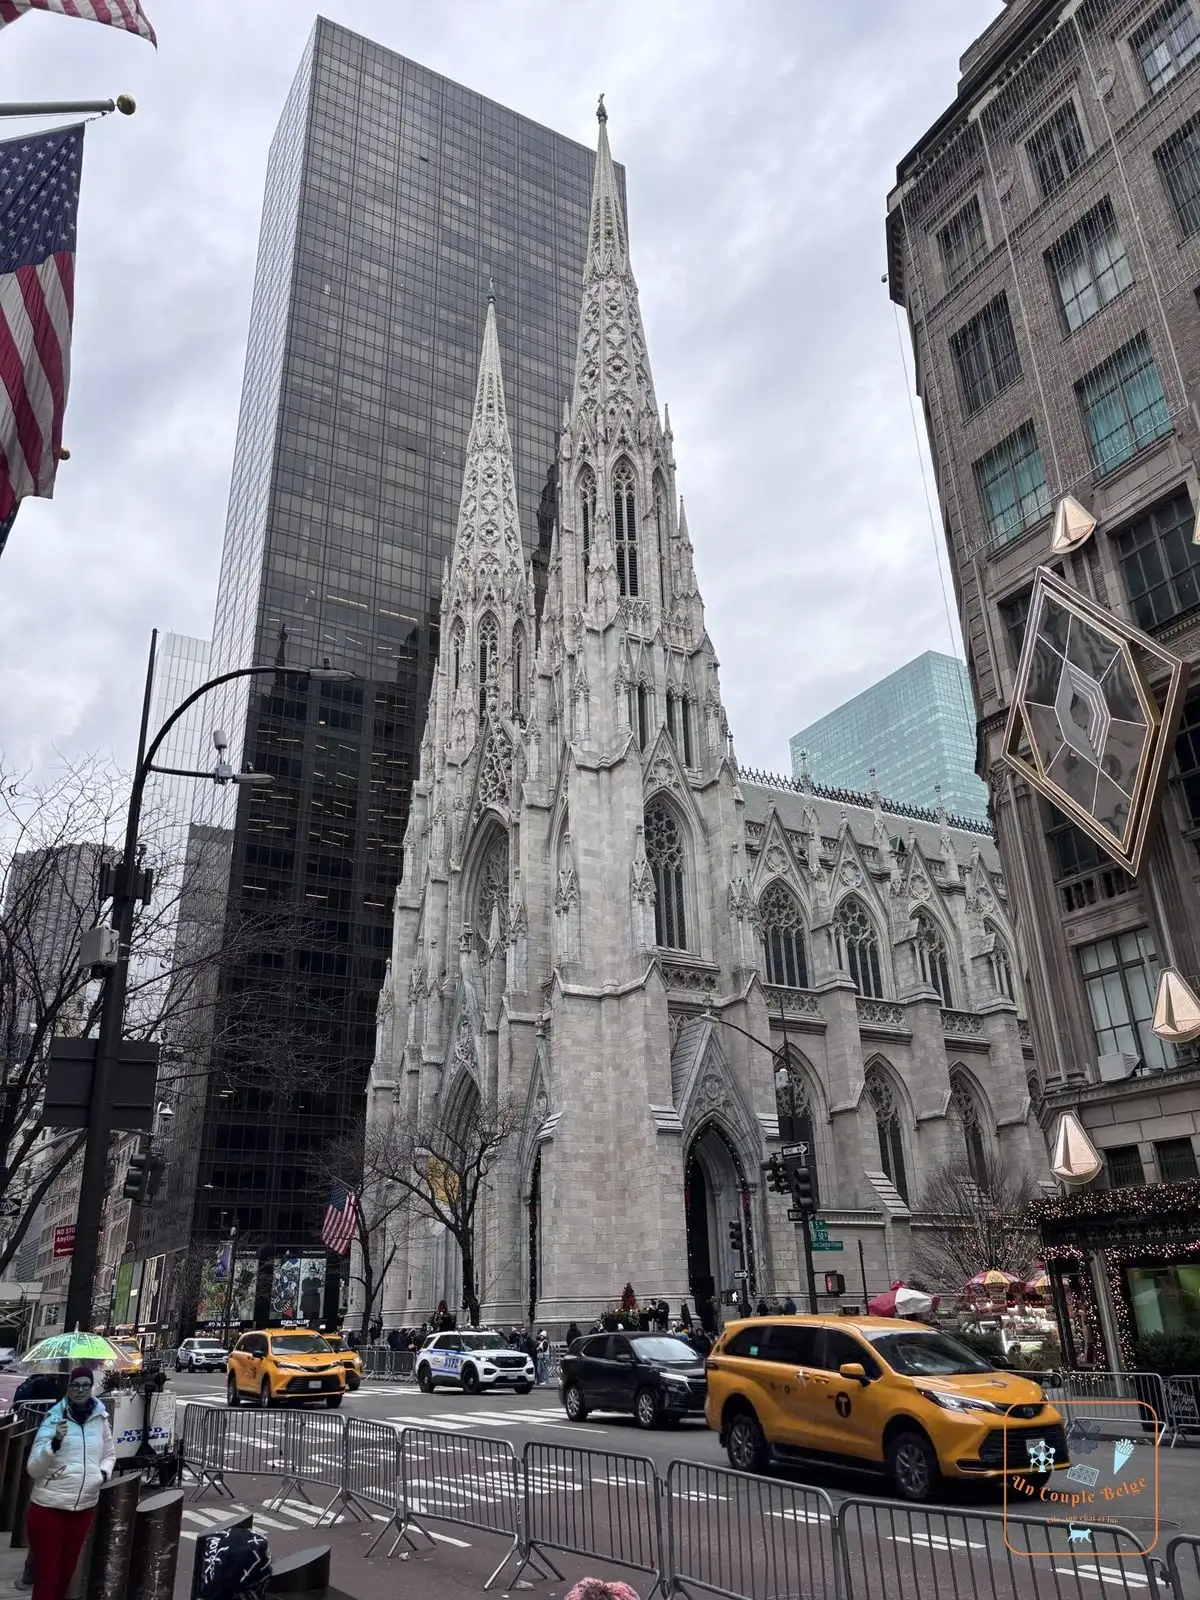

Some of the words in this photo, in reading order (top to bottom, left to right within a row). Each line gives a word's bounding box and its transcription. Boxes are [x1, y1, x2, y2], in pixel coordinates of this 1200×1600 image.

[56, 1235, 76, 1243] Anytim
[123, 1426, 163, 1436] NYD
[116, 1432, 169, 1444] POLCE
